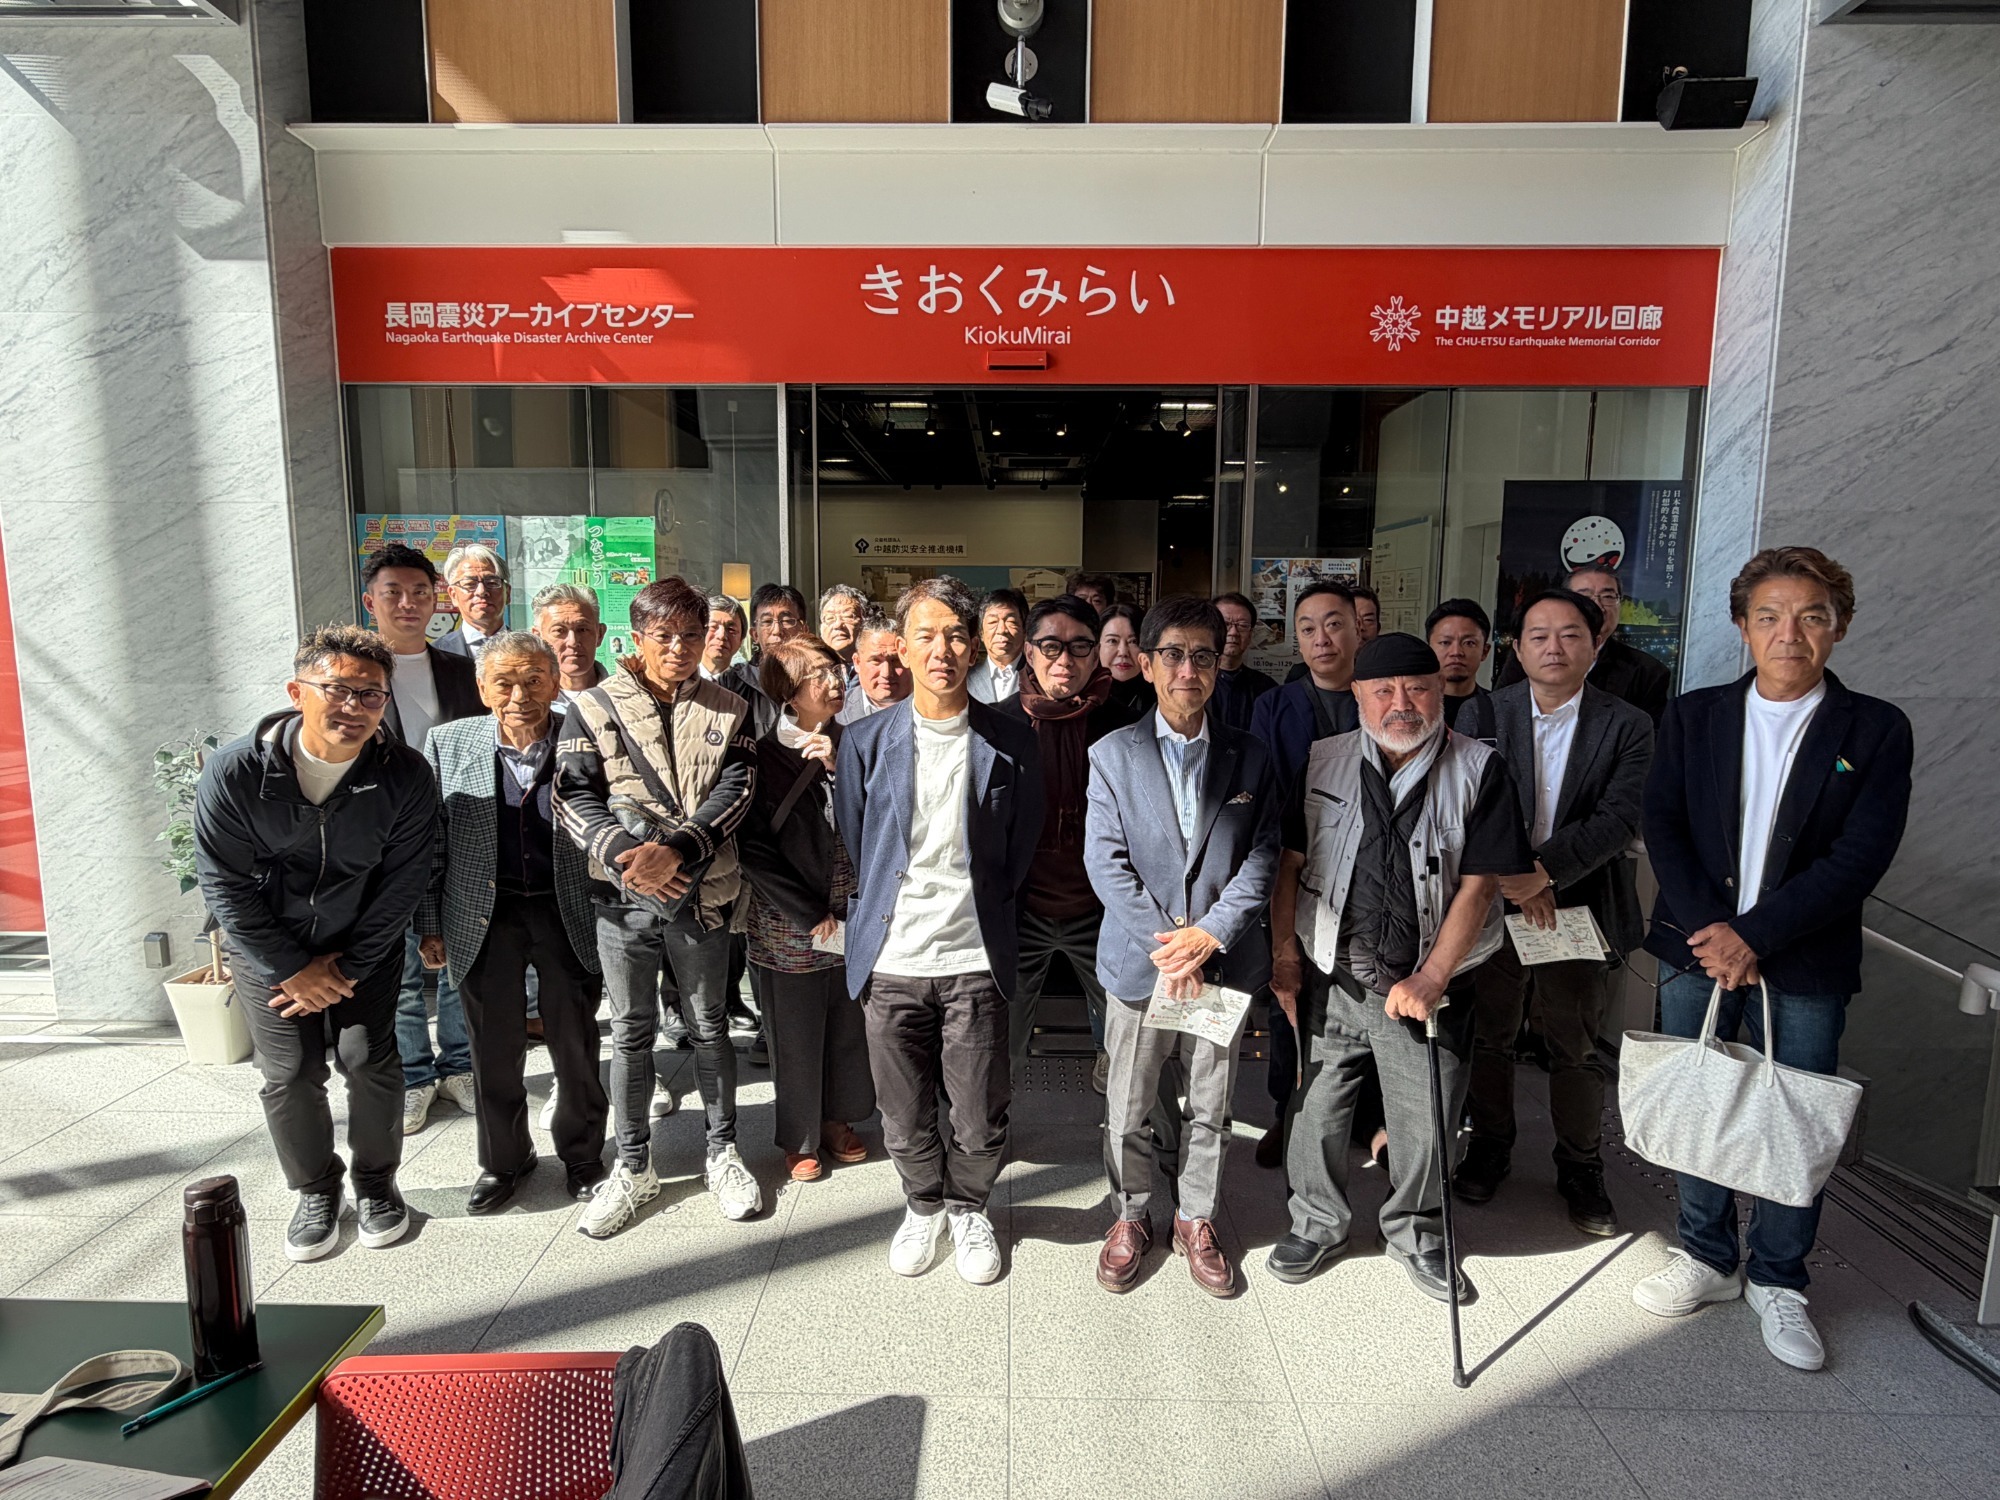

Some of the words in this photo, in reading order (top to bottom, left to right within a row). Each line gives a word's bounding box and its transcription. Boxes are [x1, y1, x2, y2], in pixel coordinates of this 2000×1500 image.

[860, 263, 1176, 317] きおくみらい
[384, 302, 695, 329] 長岡震災アーカイブセンター
[1435, 304, 1664, 331] 中越メモリアル回廊
[385, 331, 439, 346] Nagaoka
[442, 331, 511, 346] Earthquake
[513, 331, 563, 344] Disaster
[564, 331, 611, 344] Archive
[613, 332, 654, 344] Center
[964, 325, 1071, 345] KiokuMirai
[1435, 336, 1454, 346] The
[1455, 336, 1507, 346] CHU-ETSU
[1508, 336, 1567, 348] Earthquake
[1568, 336, 1617, 346] Memorial
[1618, 336, 1661, 346] Corridor
[588, 525, 605, 587] つなごう
[873, 544, 965, 555] 中越防災安全推進機構
